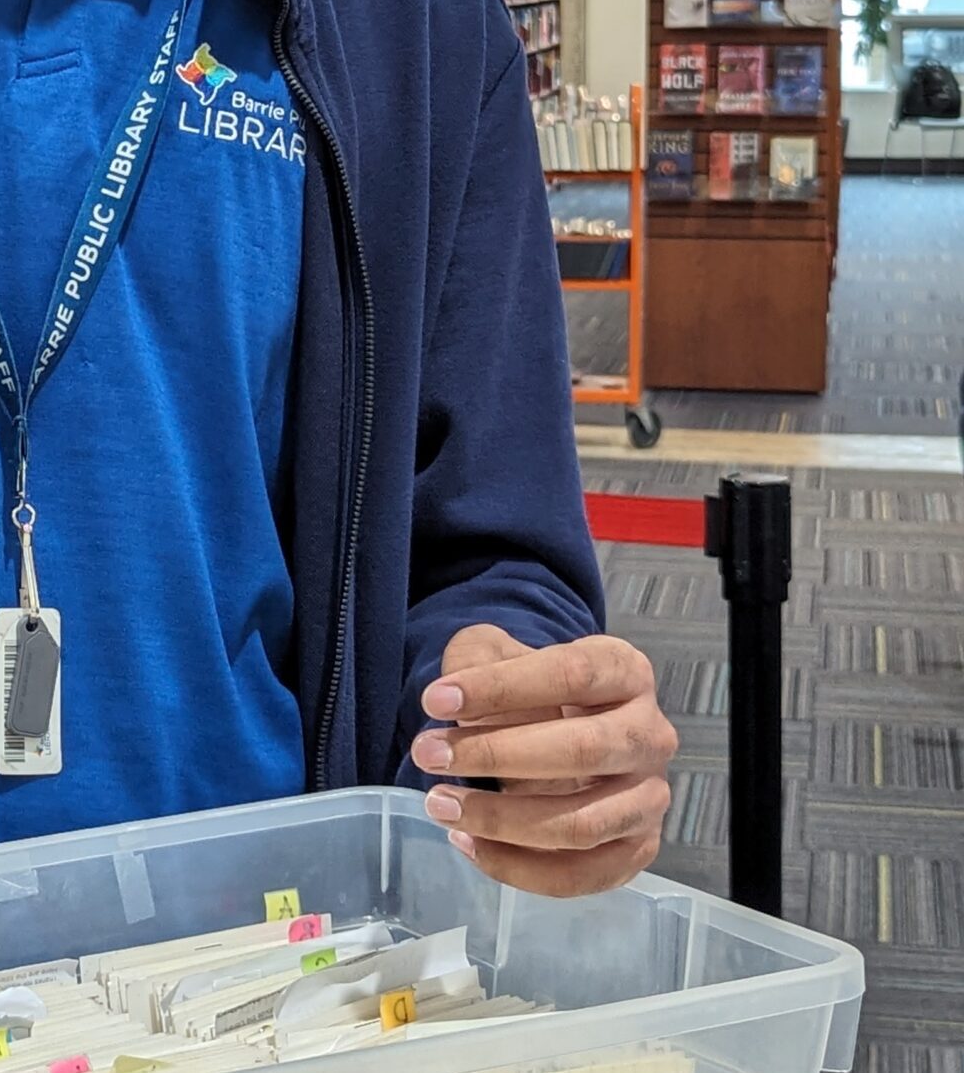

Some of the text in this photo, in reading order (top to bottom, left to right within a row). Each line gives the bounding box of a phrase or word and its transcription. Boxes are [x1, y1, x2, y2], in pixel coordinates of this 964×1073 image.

[661, 54, 704, 69] BLACK
[661, 73, 705, 89] WOLF
[231, 90, 286, 121] Barrie
[178, 101, 307, 167] LIBRAR
[31, 8, 181, 389] ARRIE PUBLIC LIBRARY STAFF
[278, 895, 295, 920] A
